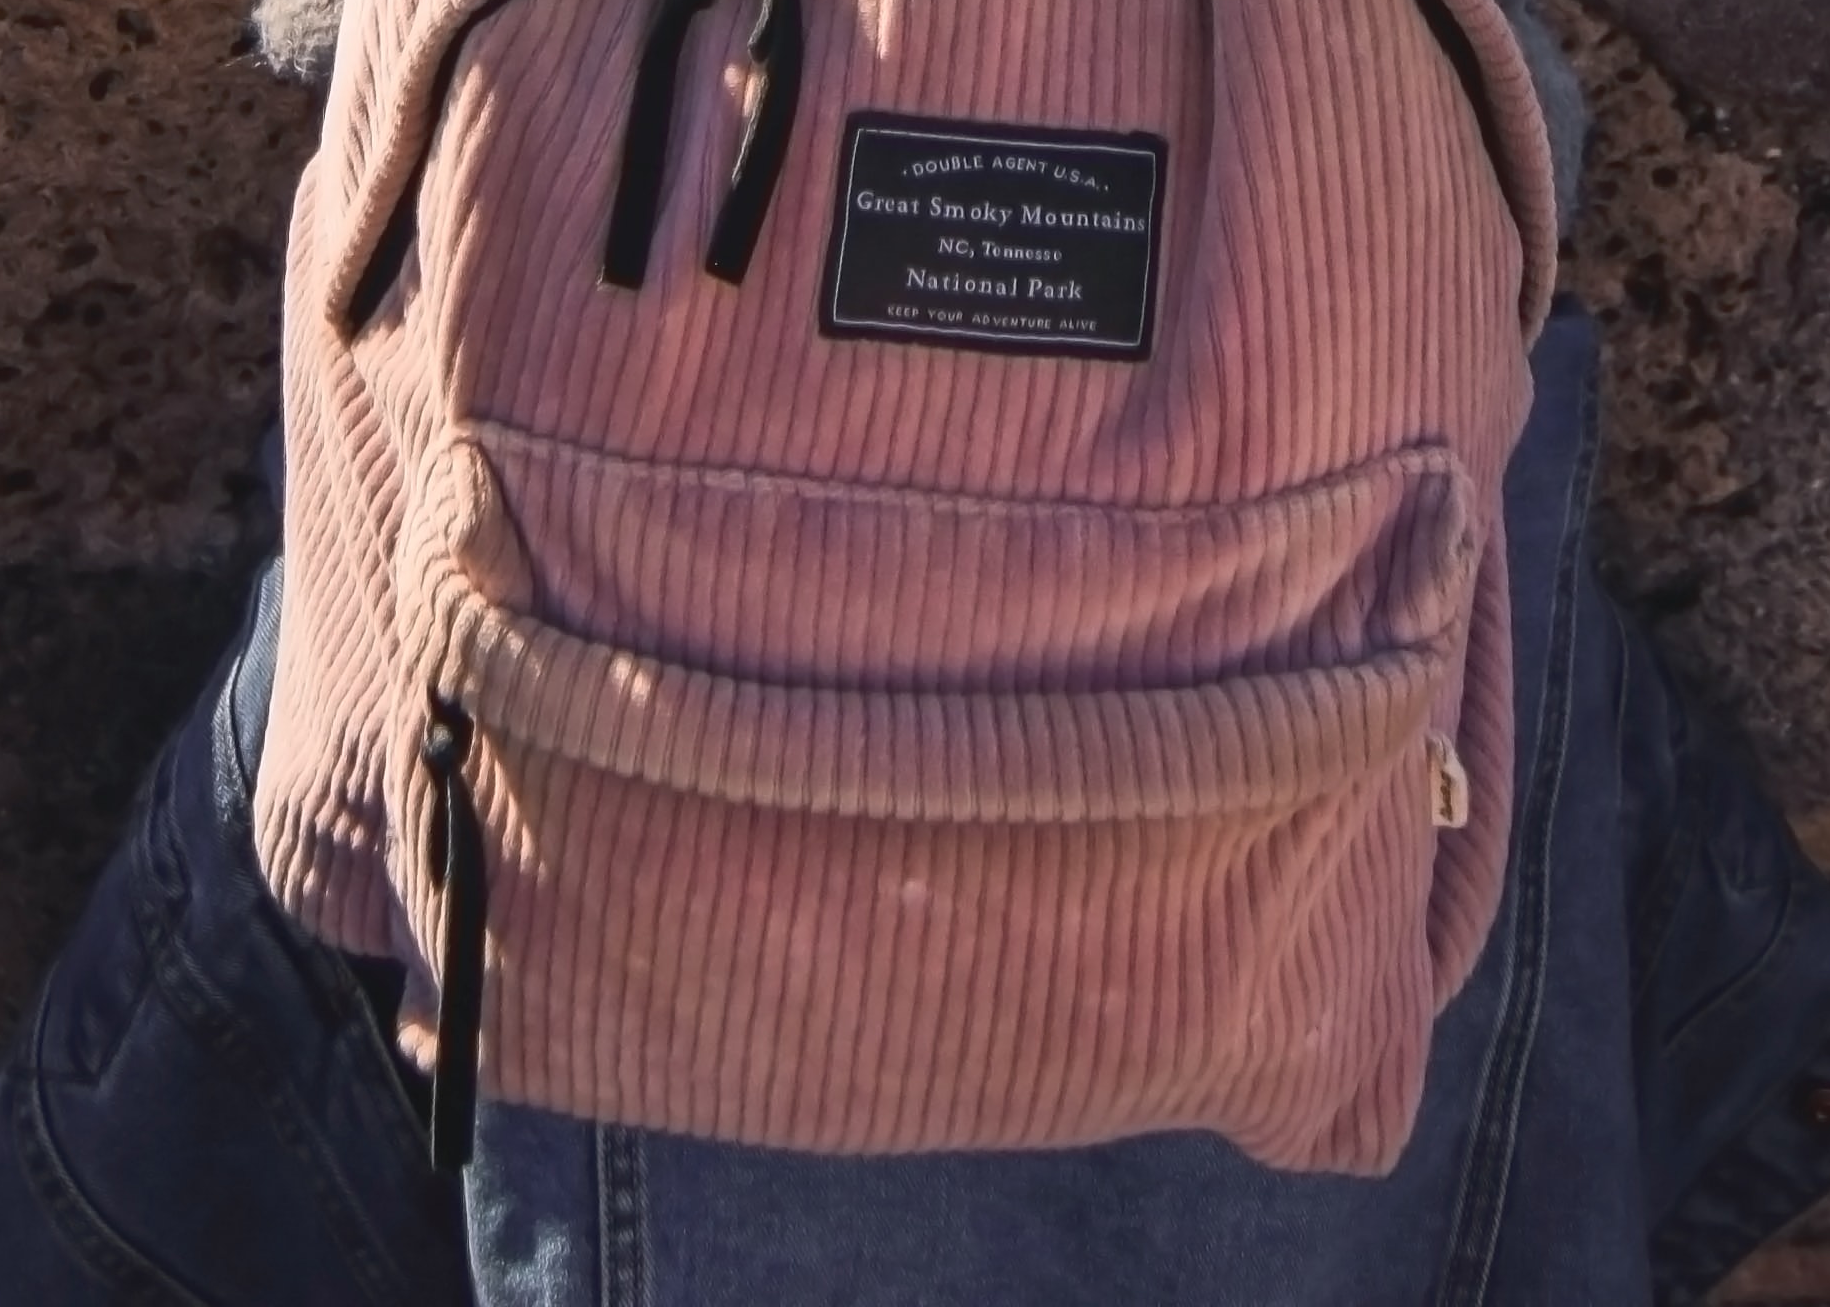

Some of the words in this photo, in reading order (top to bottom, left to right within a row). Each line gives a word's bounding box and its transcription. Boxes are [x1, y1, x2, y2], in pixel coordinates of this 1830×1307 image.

[913, 156, 984, 176] DOUBLE
[992, 156, 1049, 174] AGENT
[857, 191, 920, 215] Great
[930, 196, 1012, 228] Smoky
[1021, 205, 1145, 232] Mountains
[938, 238, 975, 259] NC,
[907, 268, 1017, 295] National
[1027, 279, 1083, 300] Park
[887, 306, 919, 317] KEEP
[928, 309, 964, 322] YOUR
[972, 314, 1051, 329] ADVENTURE
[1059, 319, 1097, 331] ALIVE
